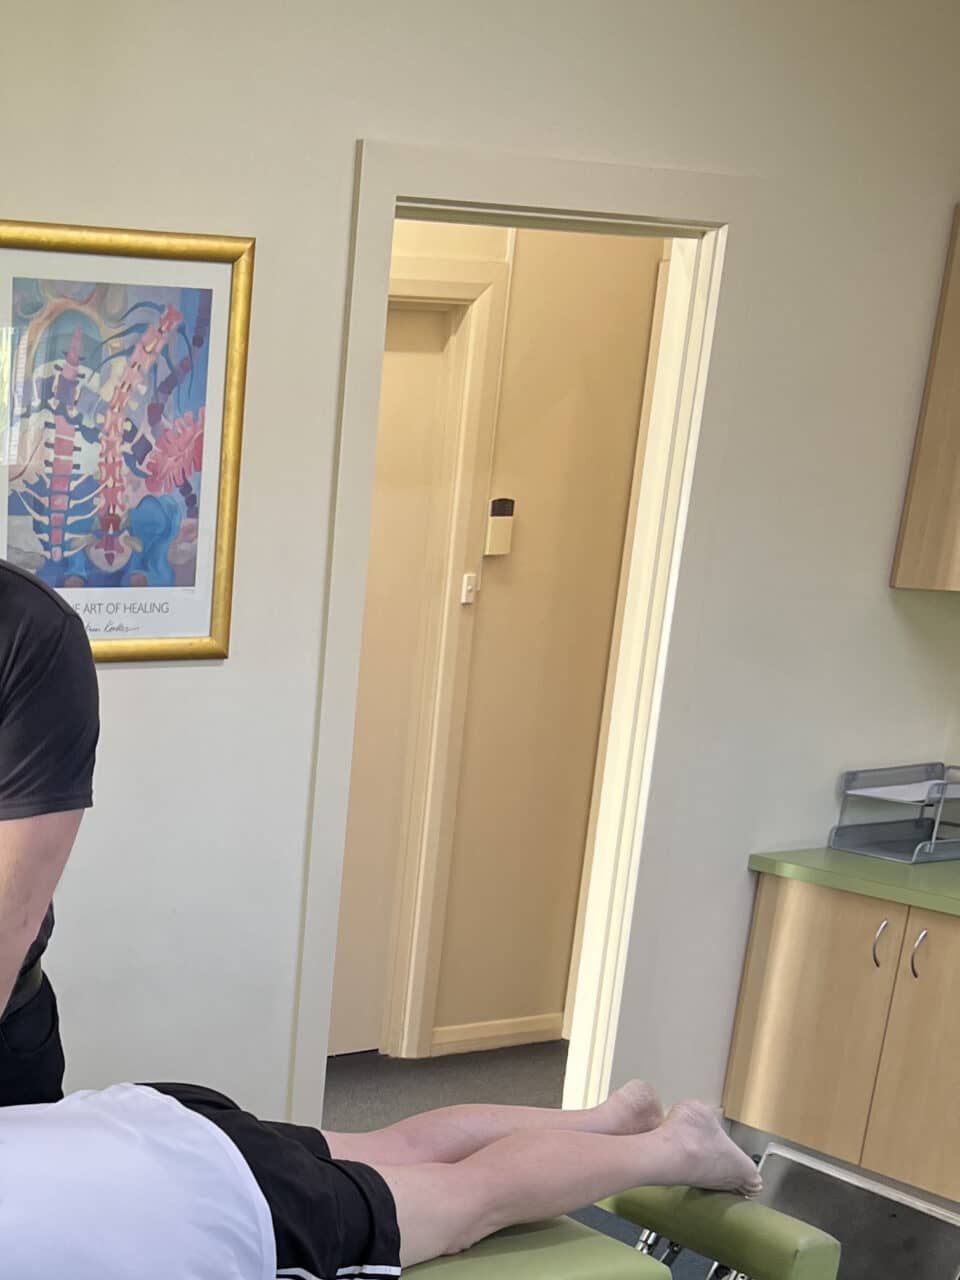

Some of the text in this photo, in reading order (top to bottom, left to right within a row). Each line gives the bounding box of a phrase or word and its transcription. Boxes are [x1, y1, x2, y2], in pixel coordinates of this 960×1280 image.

[83, 603, 104, 615] ART
[106, 602, 121, 614] OF
[123, 601, 170, 614] HEALING
